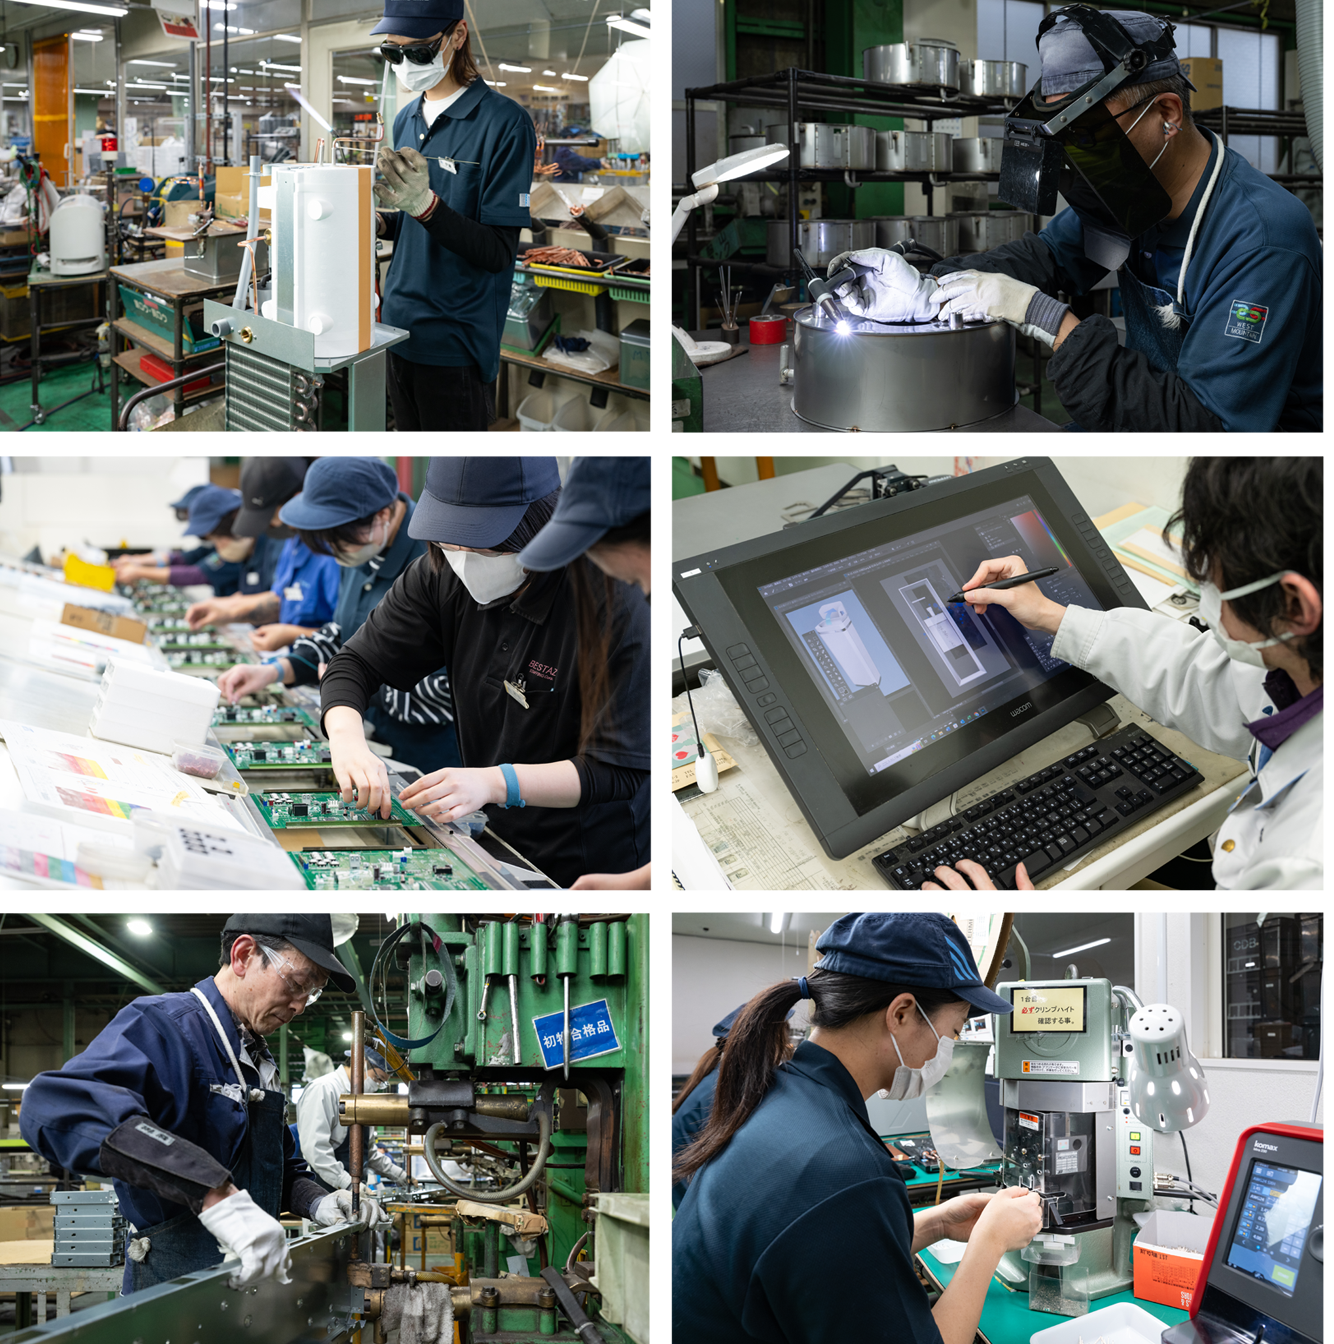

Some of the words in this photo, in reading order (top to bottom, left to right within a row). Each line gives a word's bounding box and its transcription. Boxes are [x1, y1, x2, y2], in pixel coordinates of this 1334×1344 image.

[1236, 322, 1254, 330] WEST
[1230, 328, 1257, 339] MOUNTAIN
[529, 660, 558, 676] BESTAZ
[1010, 702, 1032, 717] wacom
[1254, 1140, 1278, 1151] komax
